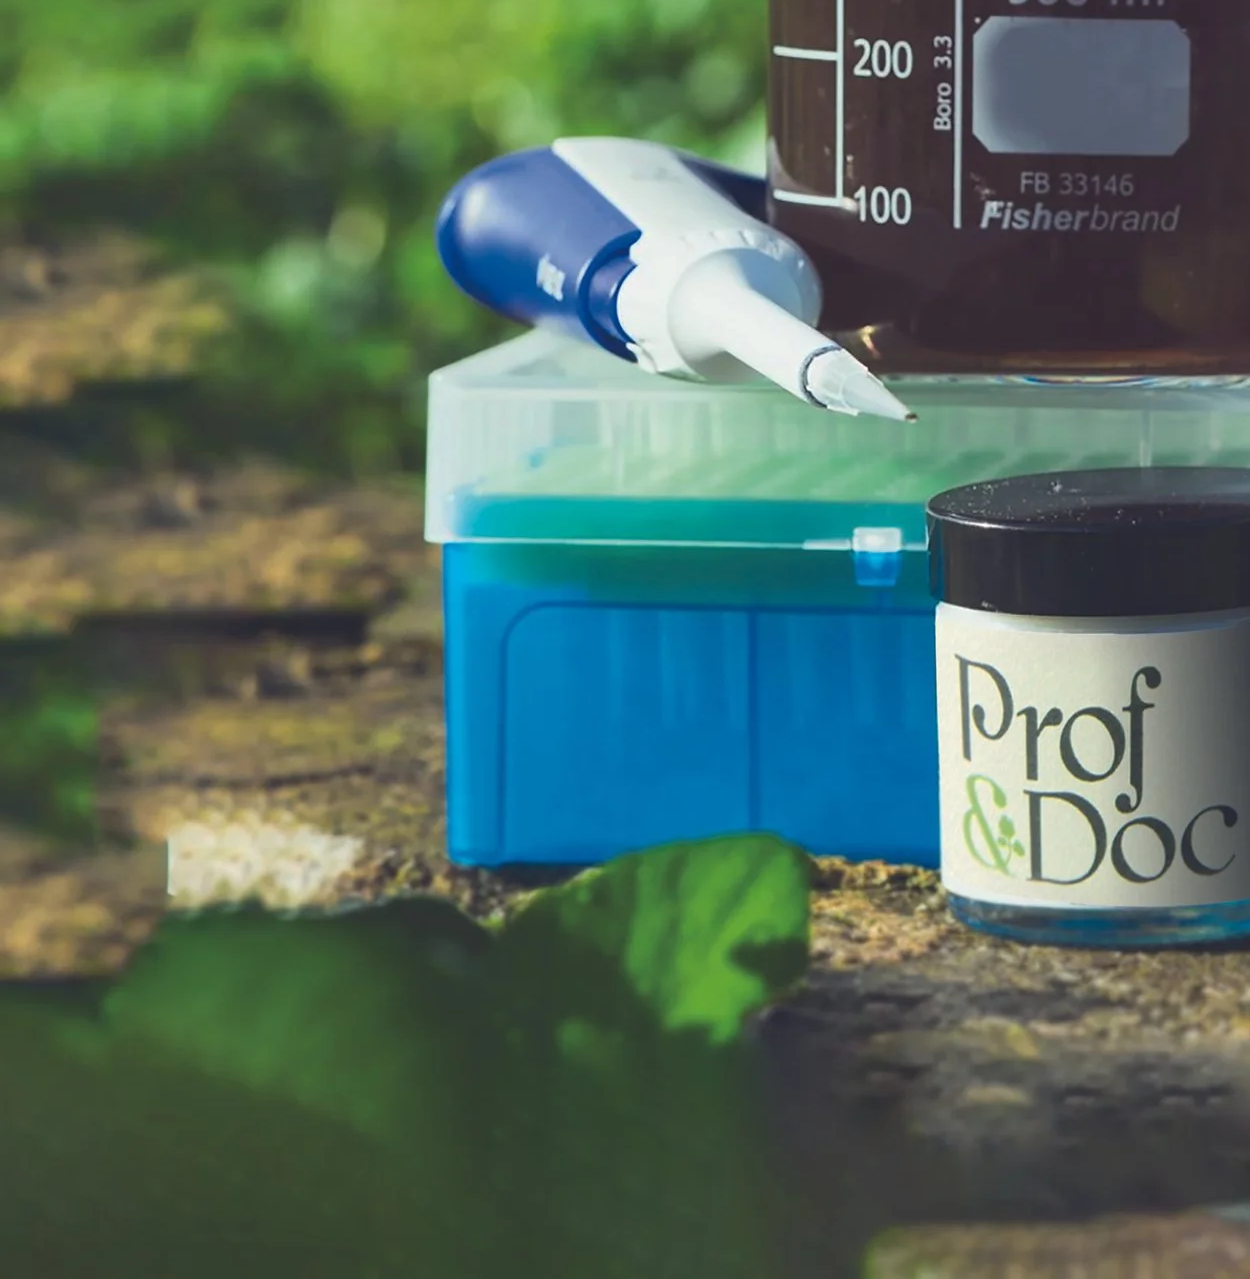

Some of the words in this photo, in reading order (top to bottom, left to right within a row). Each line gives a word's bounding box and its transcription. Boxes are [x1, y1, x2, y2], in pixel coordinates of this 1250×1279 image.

[853, 39, 913, 78] 200
[933, 35, 952, 69] 3.3
[933, 82, 952, 130] Boro
[1020, 171, 1050, 194] FB
[1059, 173, 1134, 196] 33146
[854, 186, 912, 225] 100
[980, 200, 1181, 231] Fisherbrand
[954, 653, 1162, 815] Prof
[1023, 788, 1240, 886] Doc
